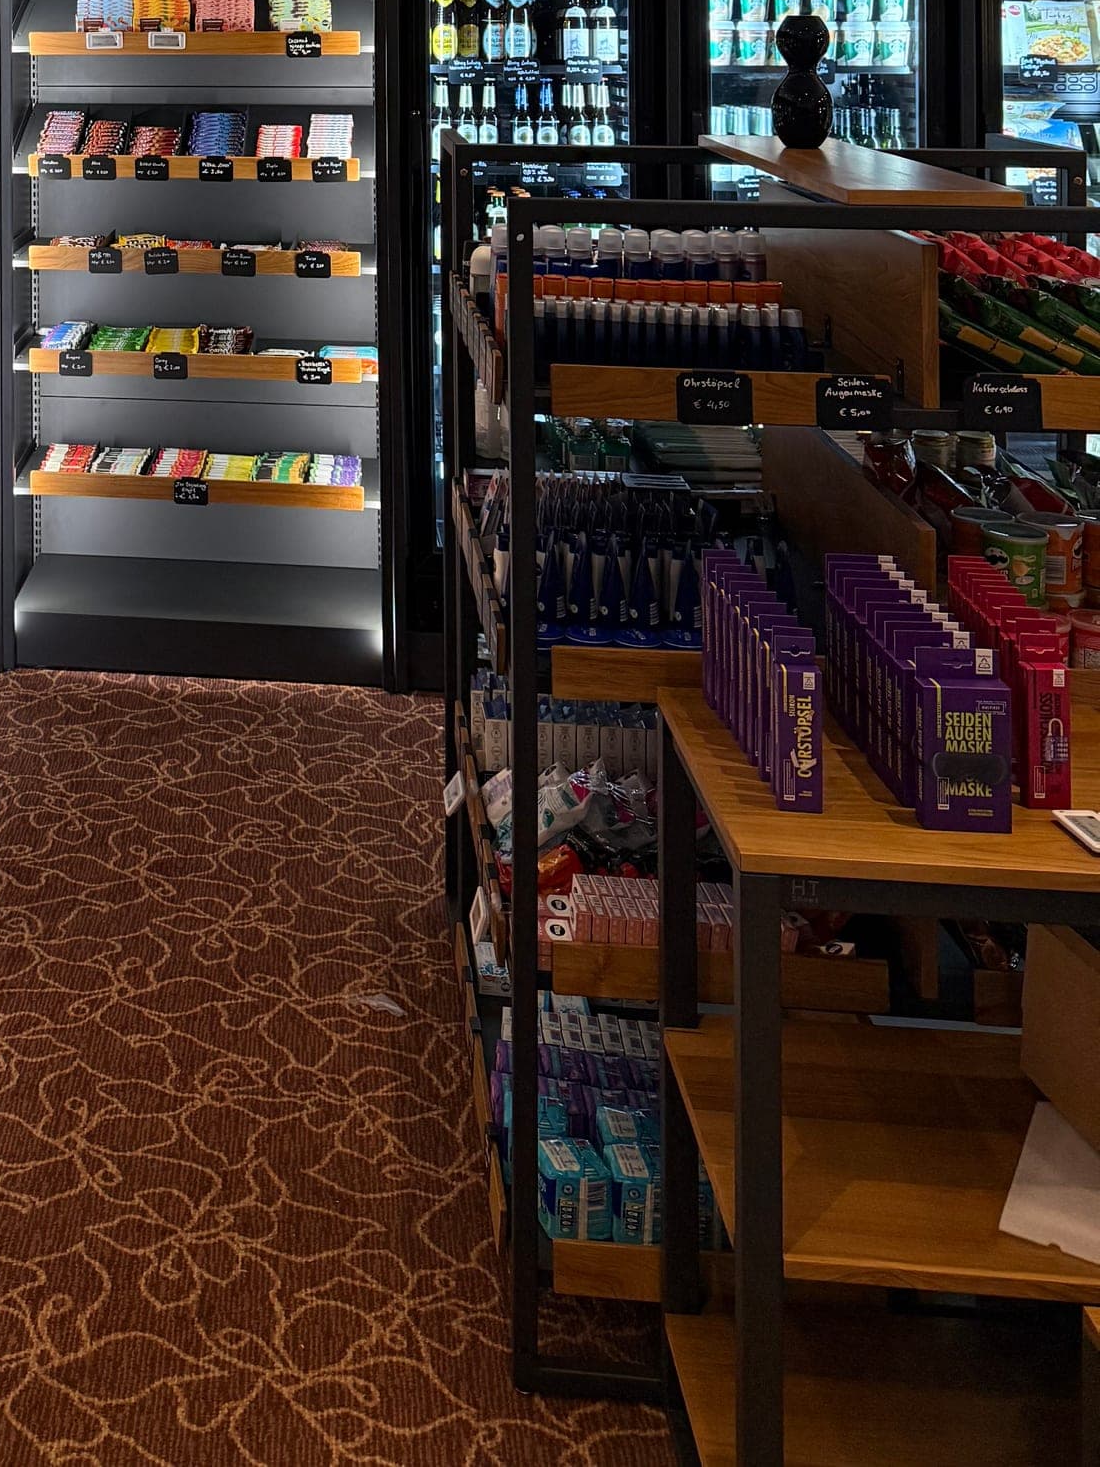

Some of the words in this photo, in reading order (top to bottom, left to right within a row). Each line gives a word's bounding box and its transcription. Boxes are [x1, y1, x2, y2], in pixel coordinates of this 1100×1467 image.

[683, 377, 740, 390] Ohrstöpsel
[839, 408, 847, 417] €
[984, 405, 992, 414] €
[945, 711, 992, 727] SEIDEN
[945, 726, 992, 741] AUGEN
[945, 740, 992, 754] MASKE
[947, 782, 993, 798] MASKE
